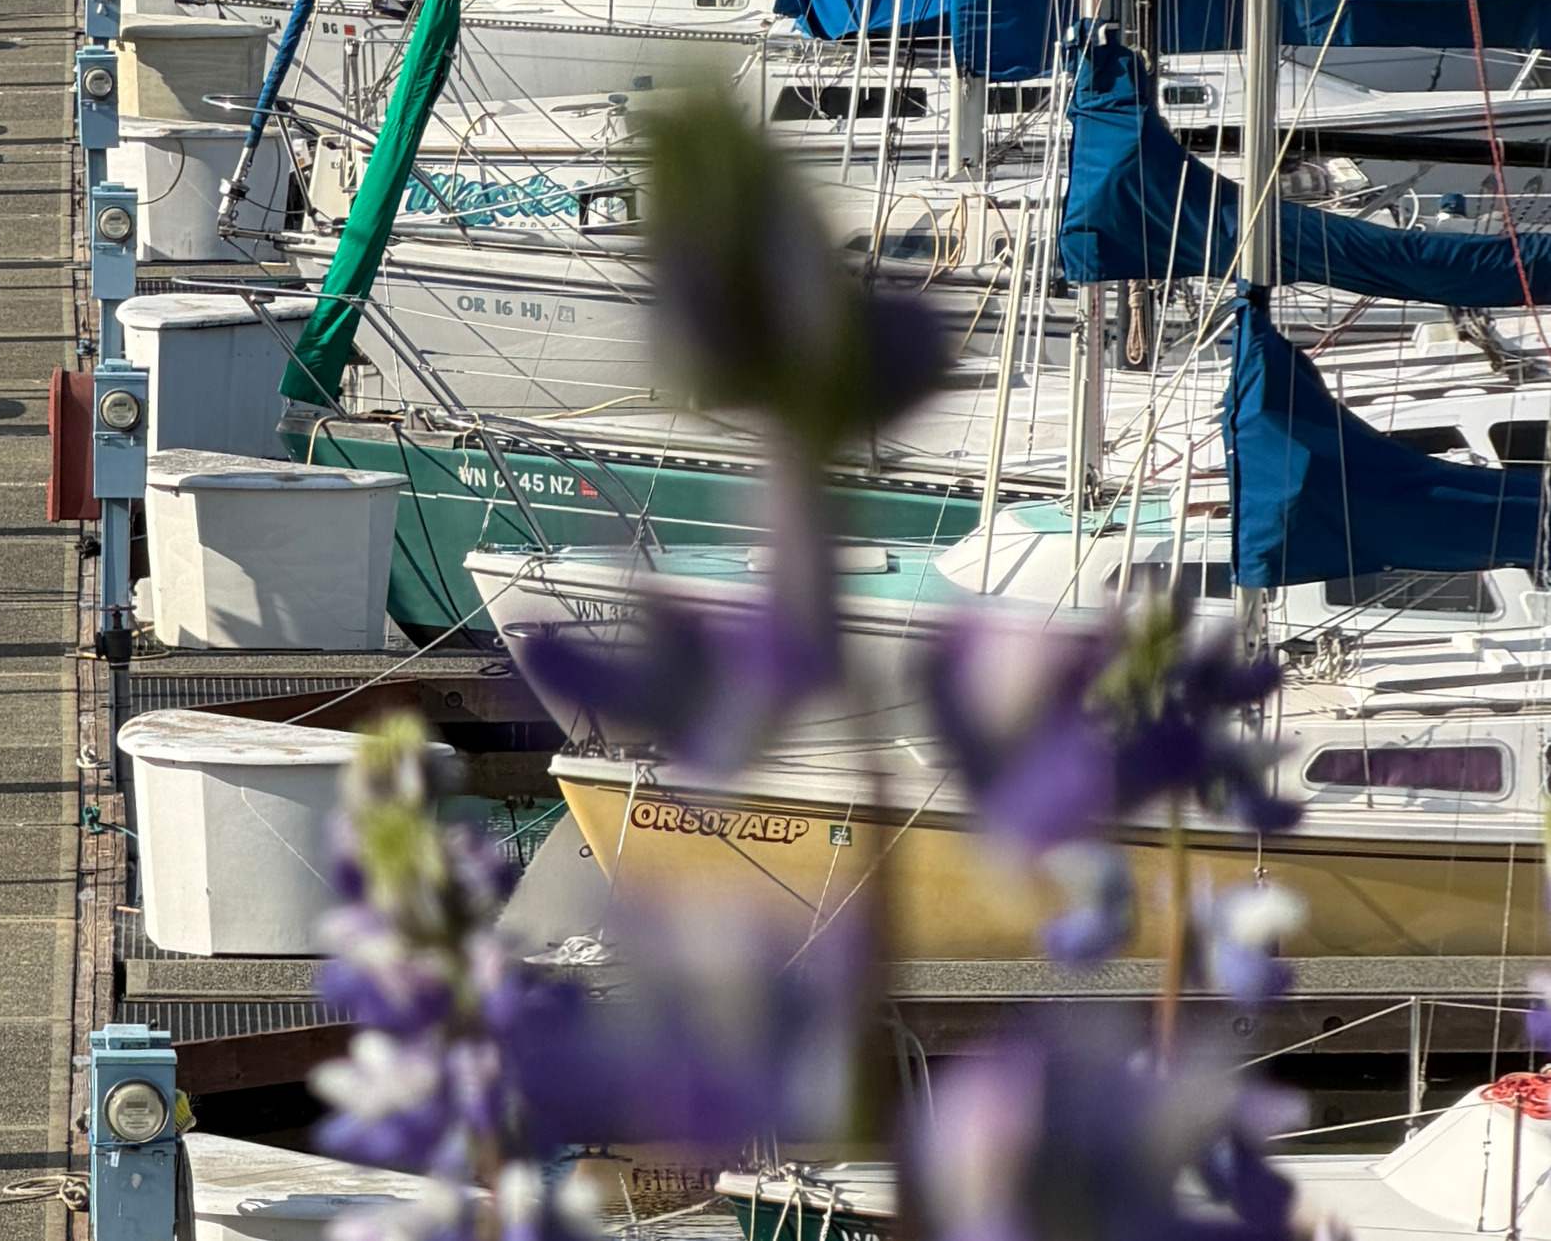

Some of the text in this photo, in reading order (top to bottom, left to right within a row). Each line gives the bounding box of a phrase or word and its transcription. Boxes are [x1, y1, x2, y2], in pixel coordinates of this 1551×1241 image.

[322, 22, 339, 35] BG
[456, 295, 487, 313] OR
[495, 299, 514, 316] 16
[458, 466, 487, 488] WN
[550, 475, 575, 496] NZ
[576, 600, 604, 623] WN
